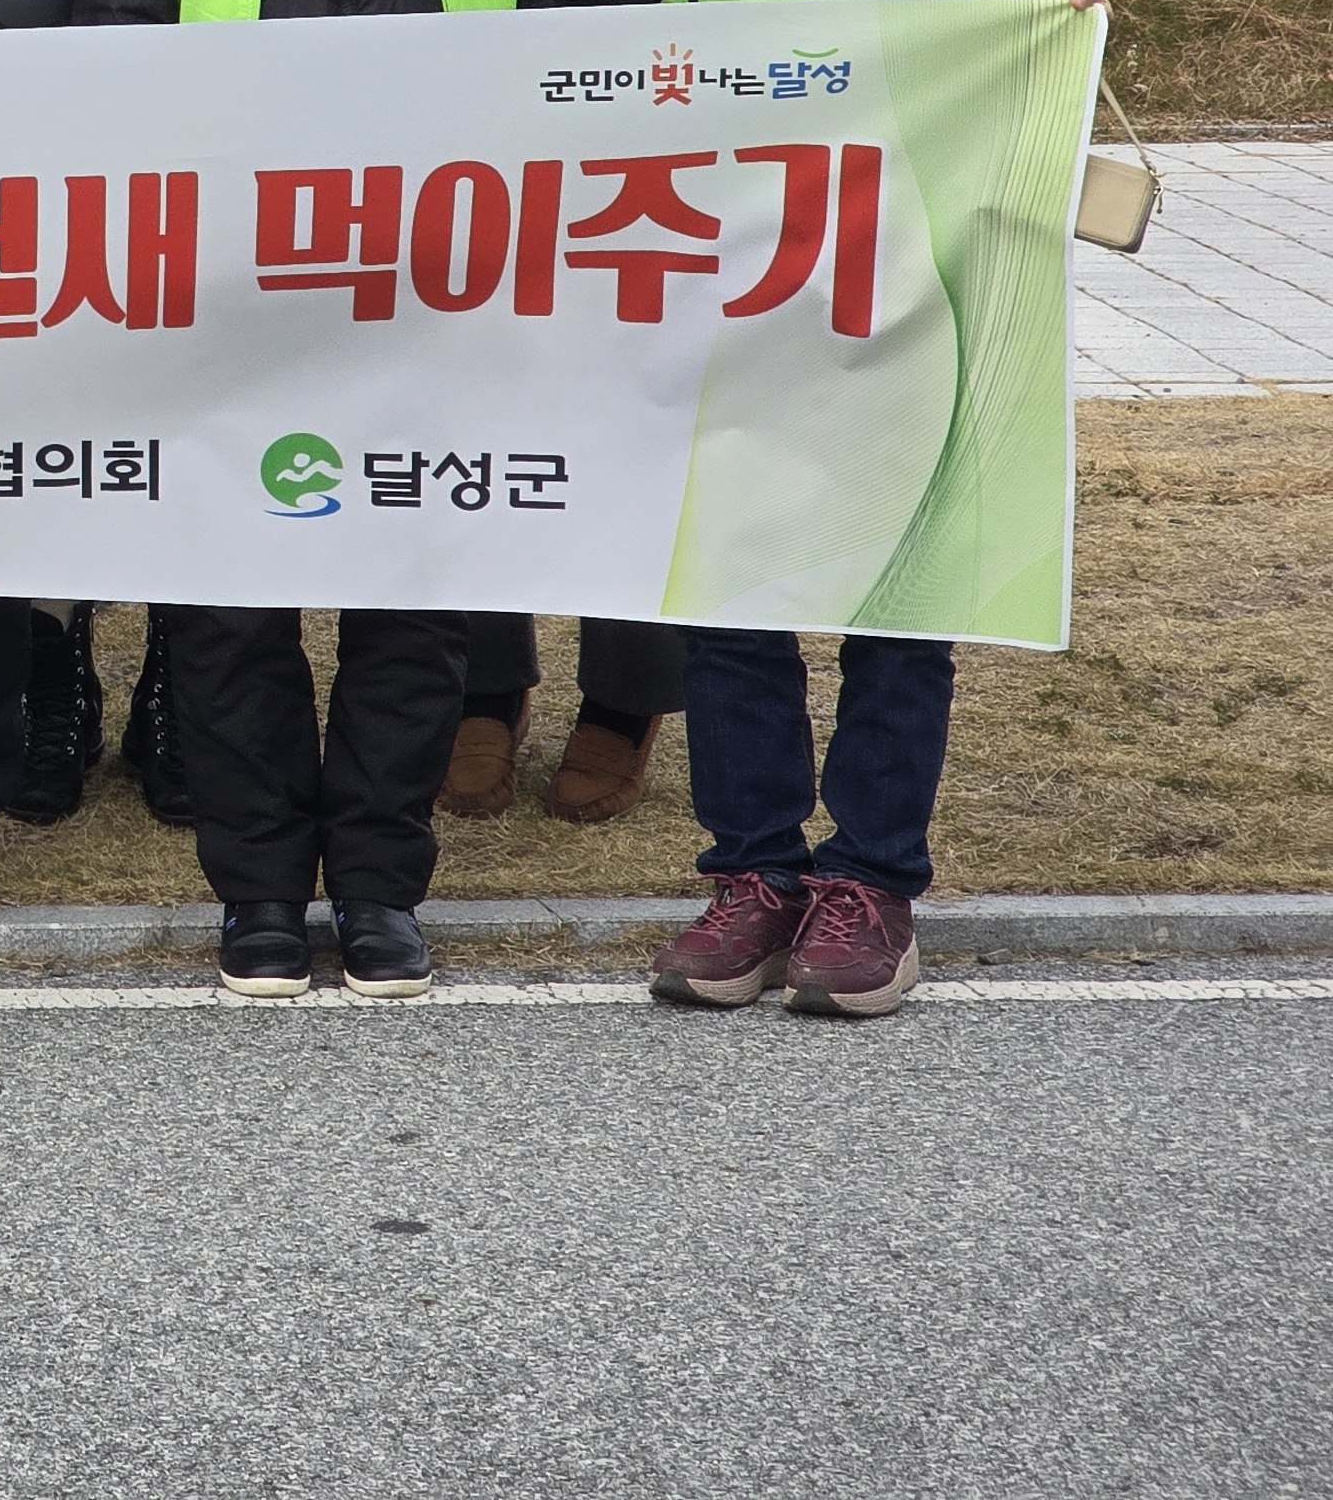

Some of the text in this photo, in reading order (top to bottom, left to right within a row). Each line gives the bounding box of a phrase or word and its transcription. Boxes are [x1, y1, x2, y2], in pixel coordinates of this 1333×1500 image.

[539, 69, 645, 103] 군민이
[767, 60, 851, 99] 달성
[256, 145, 881, 337] 먹이주기
[363, 449, 569, 511] 달성군
